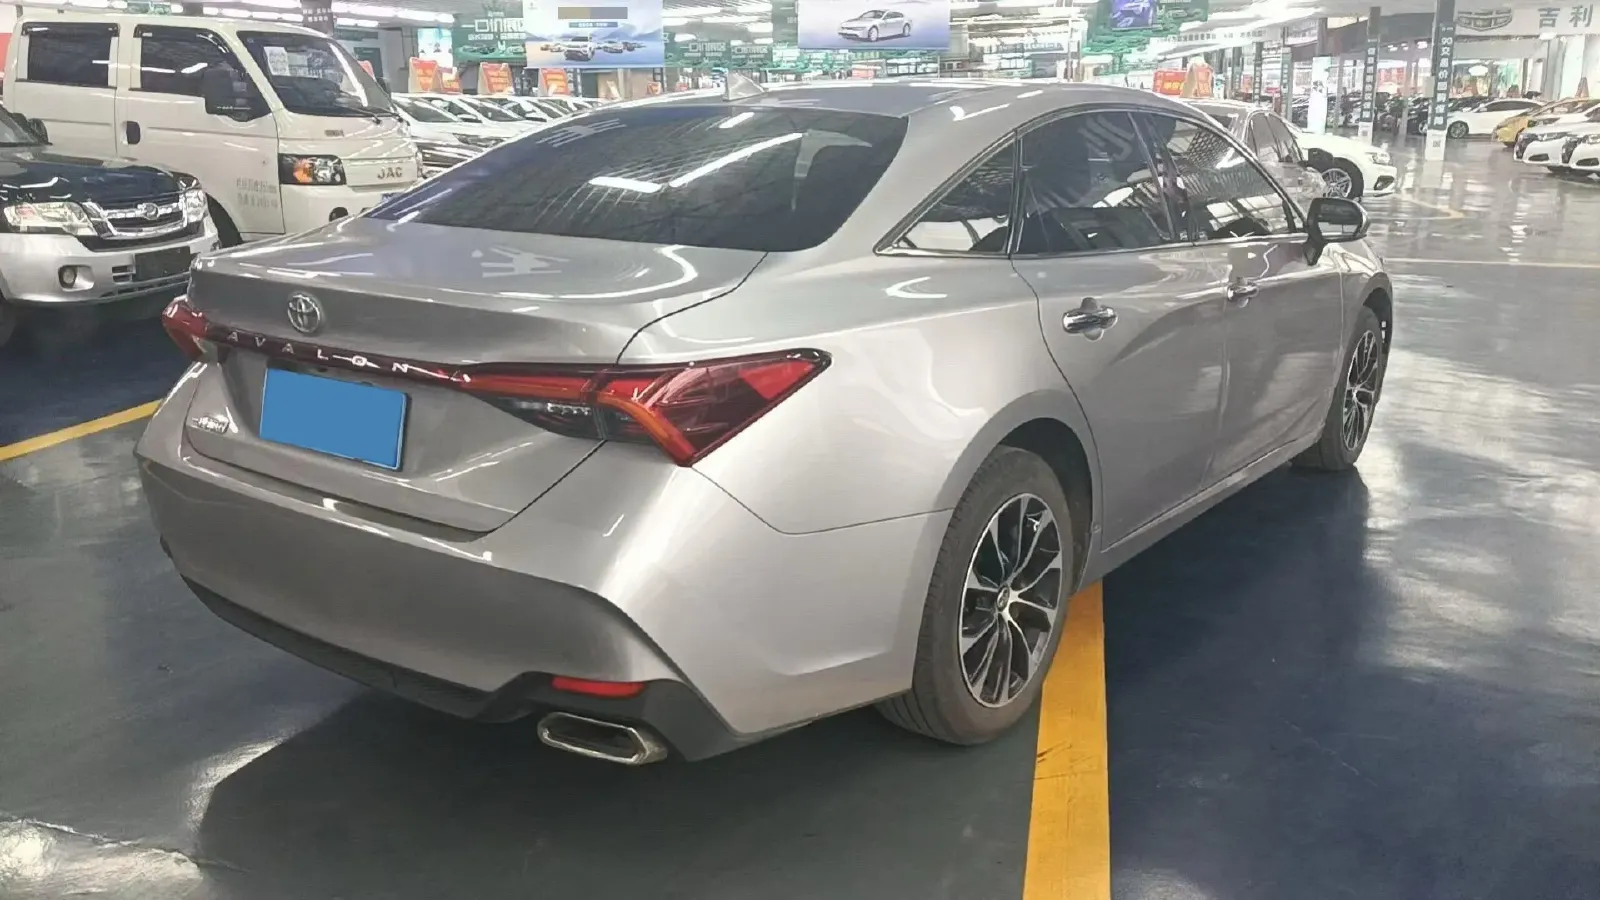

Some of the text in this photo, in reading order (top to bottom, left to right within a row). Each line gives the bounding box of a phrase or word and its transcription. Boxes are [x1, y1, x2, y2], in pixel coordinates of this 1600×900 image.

[1538, 3, 1593, 28] 吉利
[377, 167, 403, 180] JAC
[228, 331, 409, 373] AVALON
